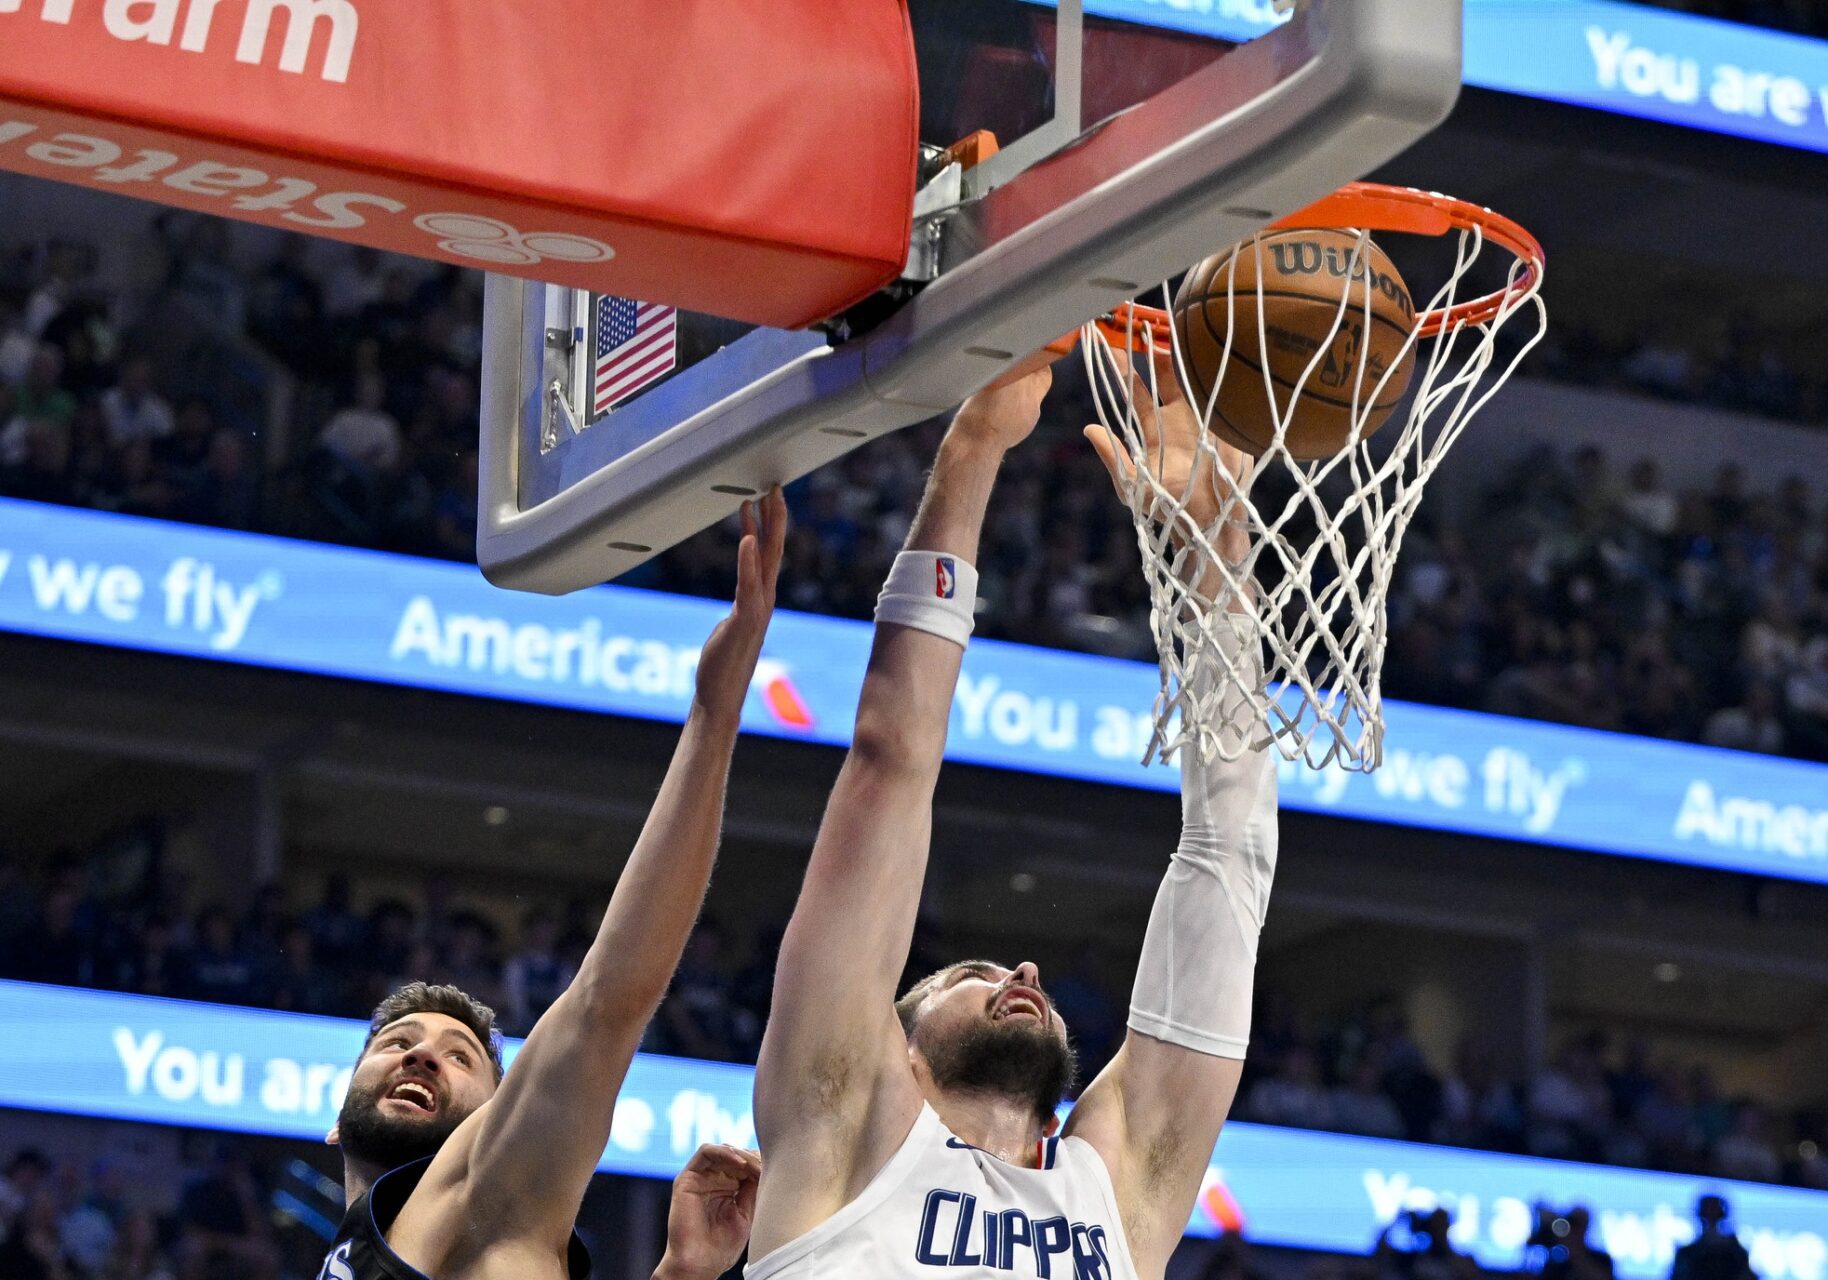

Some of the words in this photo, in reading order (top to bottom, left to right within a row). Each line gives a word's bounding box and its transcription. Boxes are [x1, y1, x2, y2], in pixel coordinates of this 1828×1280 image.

[1585, 25, 1699, 104] You
[1709, 63, 1811, 126] are
[25, 131, 407, 230] State
[28, 553, 145, 622] we
[161, 556, 260, 651] fly
[955, 672, 1079, 751] You
[1482, 746, 1568, 834] fly
[112, 1026, 244, 1107] You
